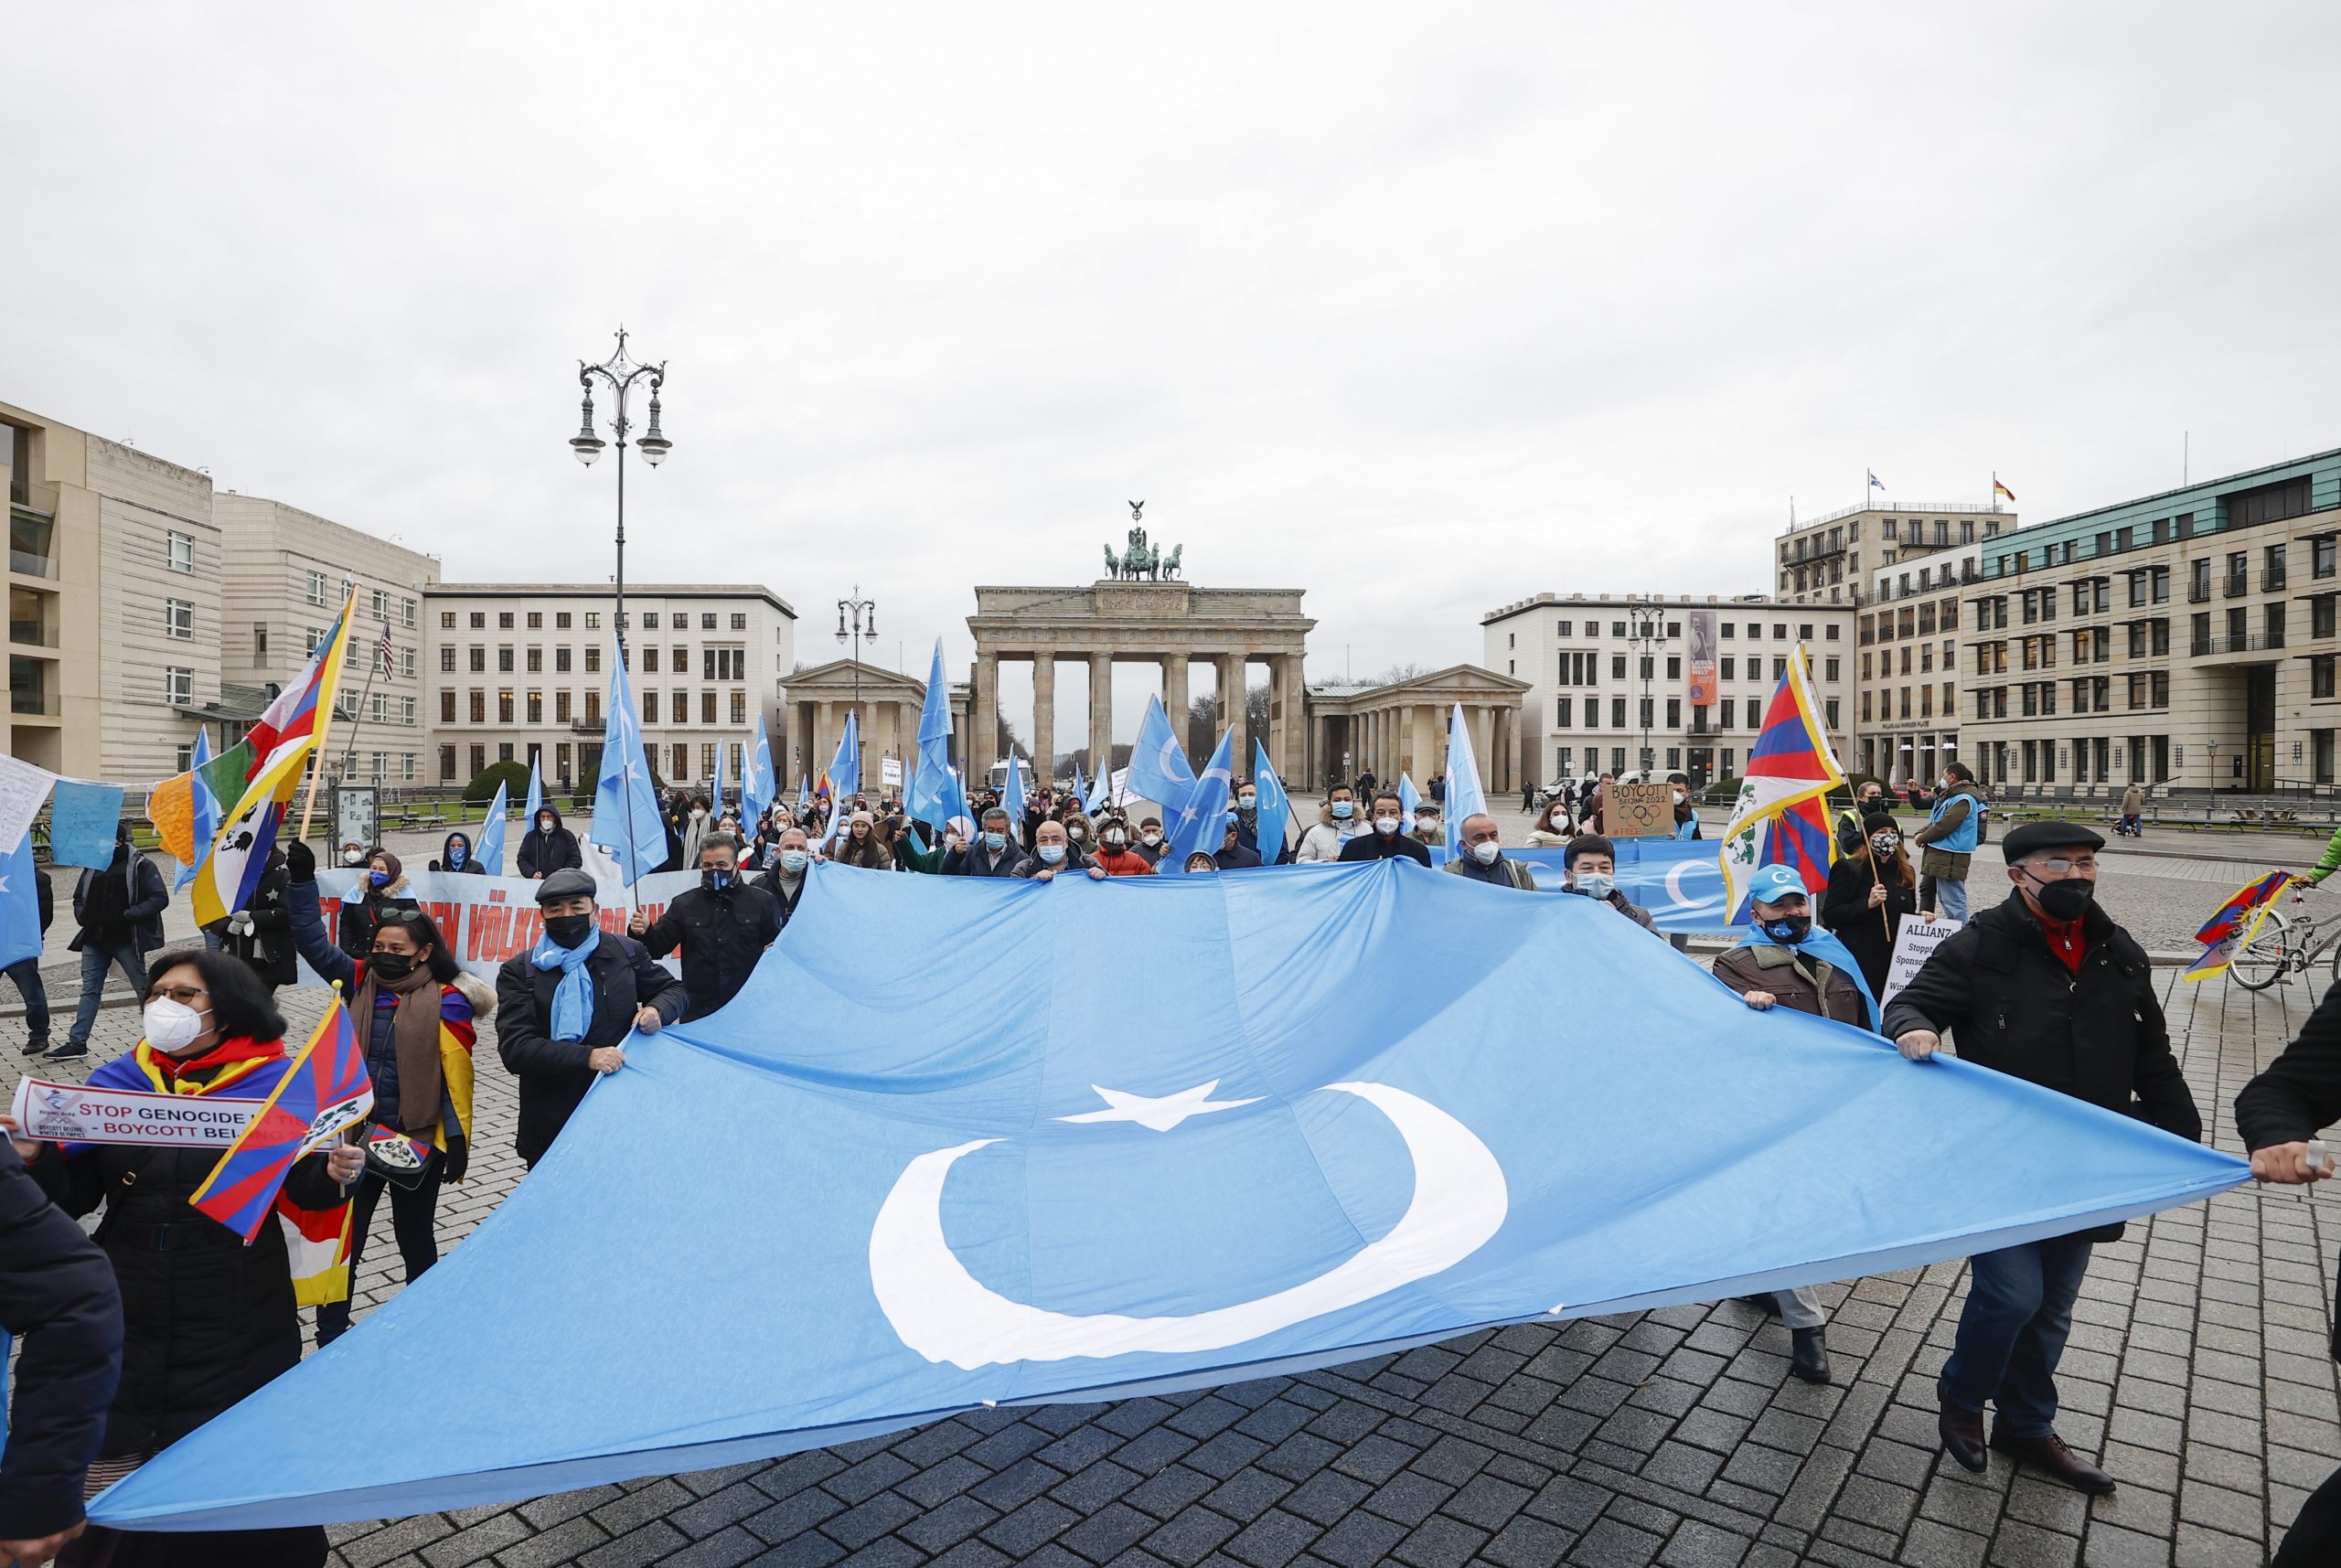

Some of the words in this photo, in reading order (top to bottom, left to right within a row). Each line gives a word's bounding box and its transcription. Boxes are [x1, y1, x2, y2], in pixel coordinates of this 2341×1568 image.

[1612, 784, 1672, 798] BOYCOTT
[1908, 943, 1933, 955] Stoppt
[80, 1103, 133, 1118] STOP
[138, 1107, 245, 1125] GENOCIDE
[103, 1122, 198, 1137] BOYCOTT
